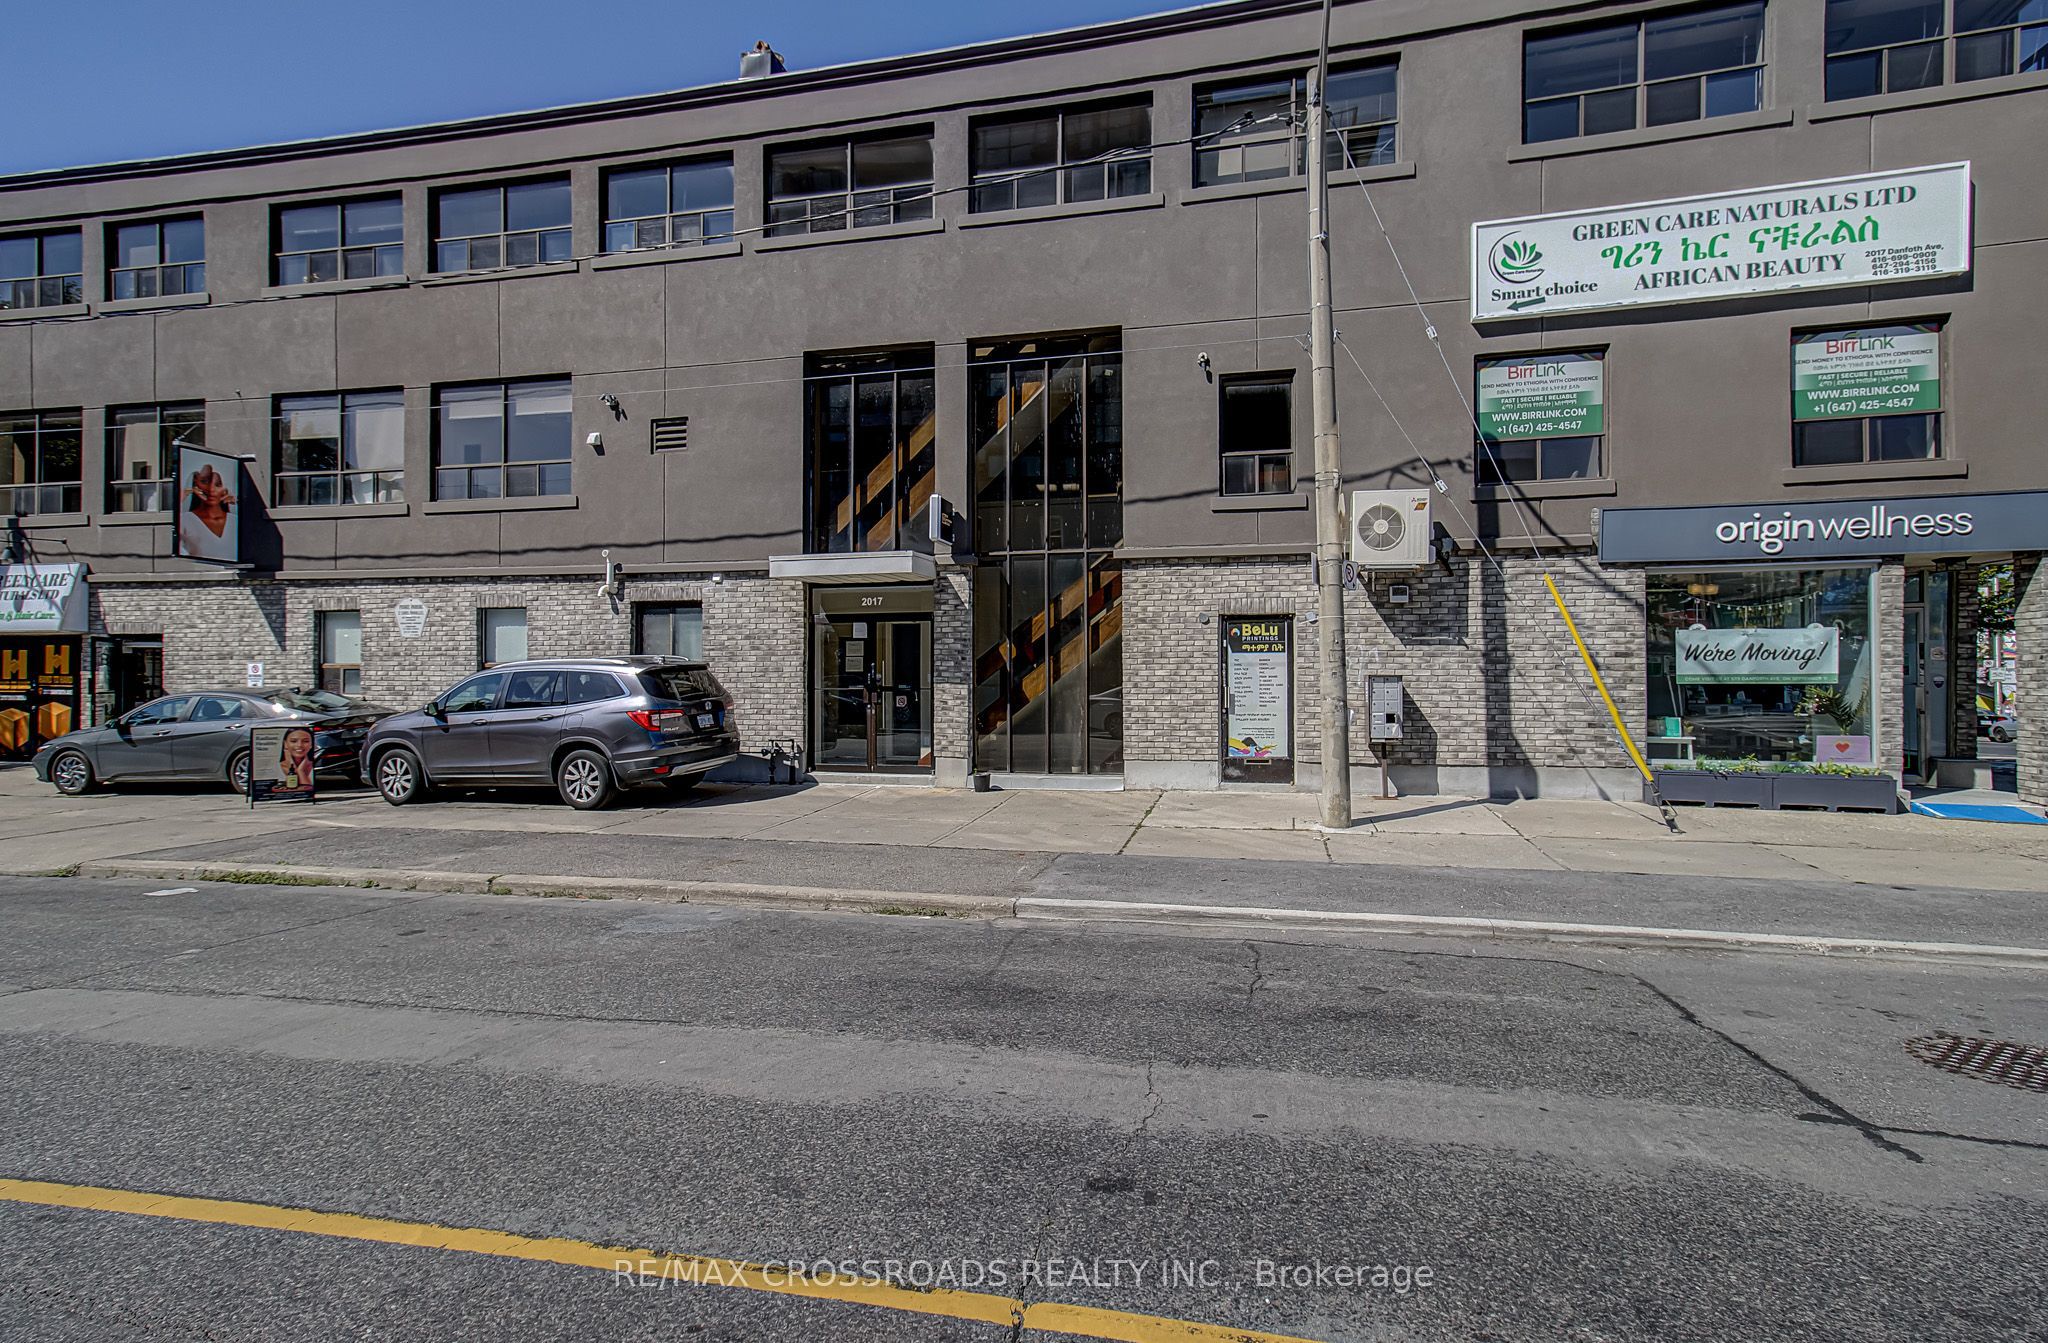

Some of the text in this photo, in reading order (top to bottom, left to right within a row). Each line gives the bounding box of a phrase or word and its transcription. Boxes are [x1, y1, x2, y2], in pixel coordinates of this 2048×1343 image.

[1572, 185, 1917, 241] GREEN CARE NATURALS LTD
[1601, 240, 1663, 269] ግሪን
[1681, 233, 1729, 261] ኬር
[1864, 243, 1944, 257] 2017 Danfoth Ave,
[1871, 251, 1937, 263] 416-699-0909
[1634, 253, 1846, 291] AFRICAN BEAUTY
[1872, 258, 1936, 270] 647-294-4156
[1872, 264, 1937, 276] 416-319-3119
[1491, 281, 1598, 302] Smart choice
[1826, 333, 1895, 355] BirrLink
[1812, 356, 1834, 364] MONEY
[1892, 348, 1934, 357] CONFIDENCE
[1507, 361, 1567, 380] BirrLink
[1841, 371, 1870, 379] SECURE
[1874, 367, 1908, 376] RELIABLE
[1564, 375, 1599, 383] CONFIDENCE
[1519, 395, 1544, 403] SECURE
[1548, 393, 1577, 401] RELIABLE
[1807, 383, 1920, 400] WWW.BIRRLINK.COM
[1491, 407, 1587, 422] WWW.BIRRLINK.COM
[1813, 398, 1915, 415] +1 (647) 425-4547
[1496, 420, 1582, 436] +1 (647) 425-4547
[1715, 505, 1974, 554] origin wellness
[861, 596, 883, 606] 2017
[1684, 641, 1829, 671] We're Moving!
